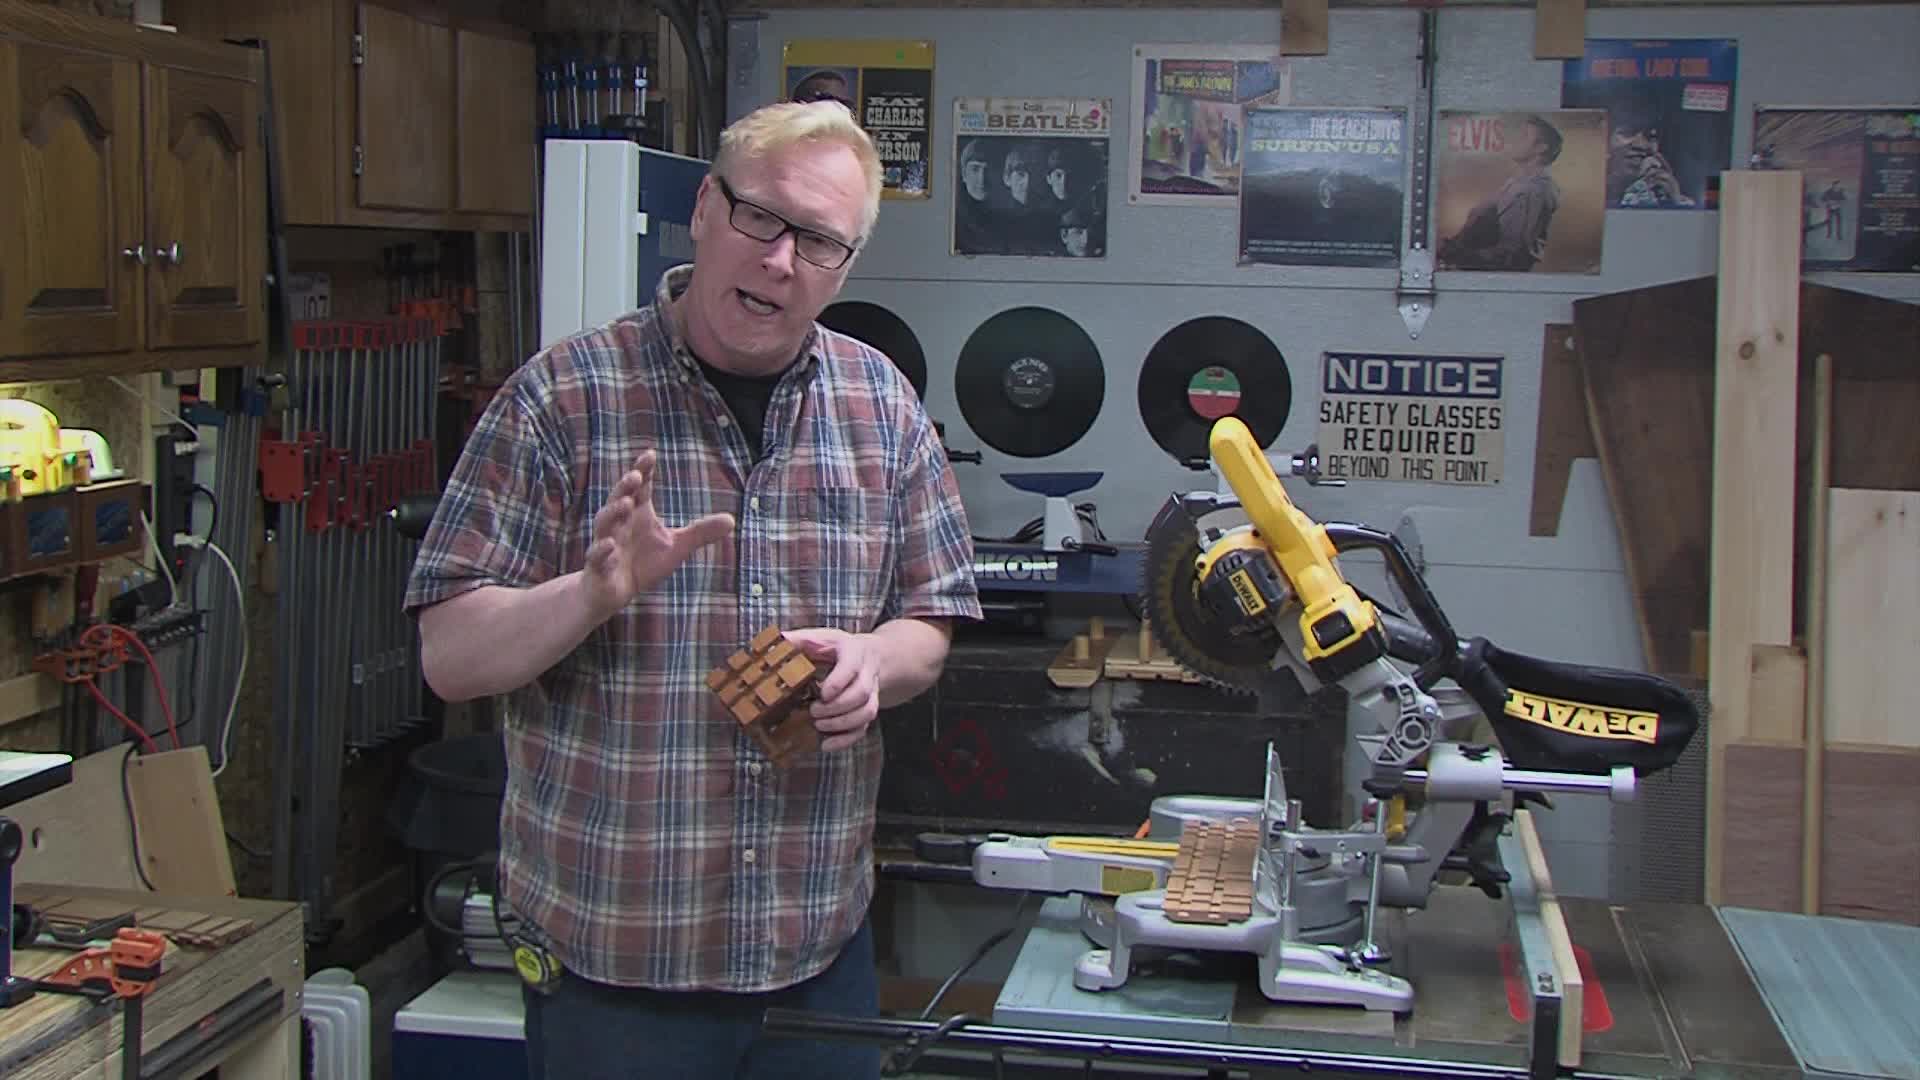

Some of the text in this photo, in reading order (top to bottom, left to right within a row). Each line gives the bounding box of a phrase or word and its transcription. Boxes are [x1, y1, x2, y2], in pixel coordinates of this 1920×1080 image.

[867, 96, 924, 106] RAY
[866, 107, 924, 126] CHARLES
[879, 132, 911, 140] IN
[1448, 117, 1505, 152] ELVIS
[878, 141, 920, 161] ERSON
[1328, 358, 1498, 394] NOTICE
[1319, 400, 1501, 430] SAFETY GLASSES
[1344, 427, 1476, 455] REQUIRED
[1328, 455, 1489, 483] BEYOND THIS POINT
[1504, 691, 1659, 741] DEWALT
